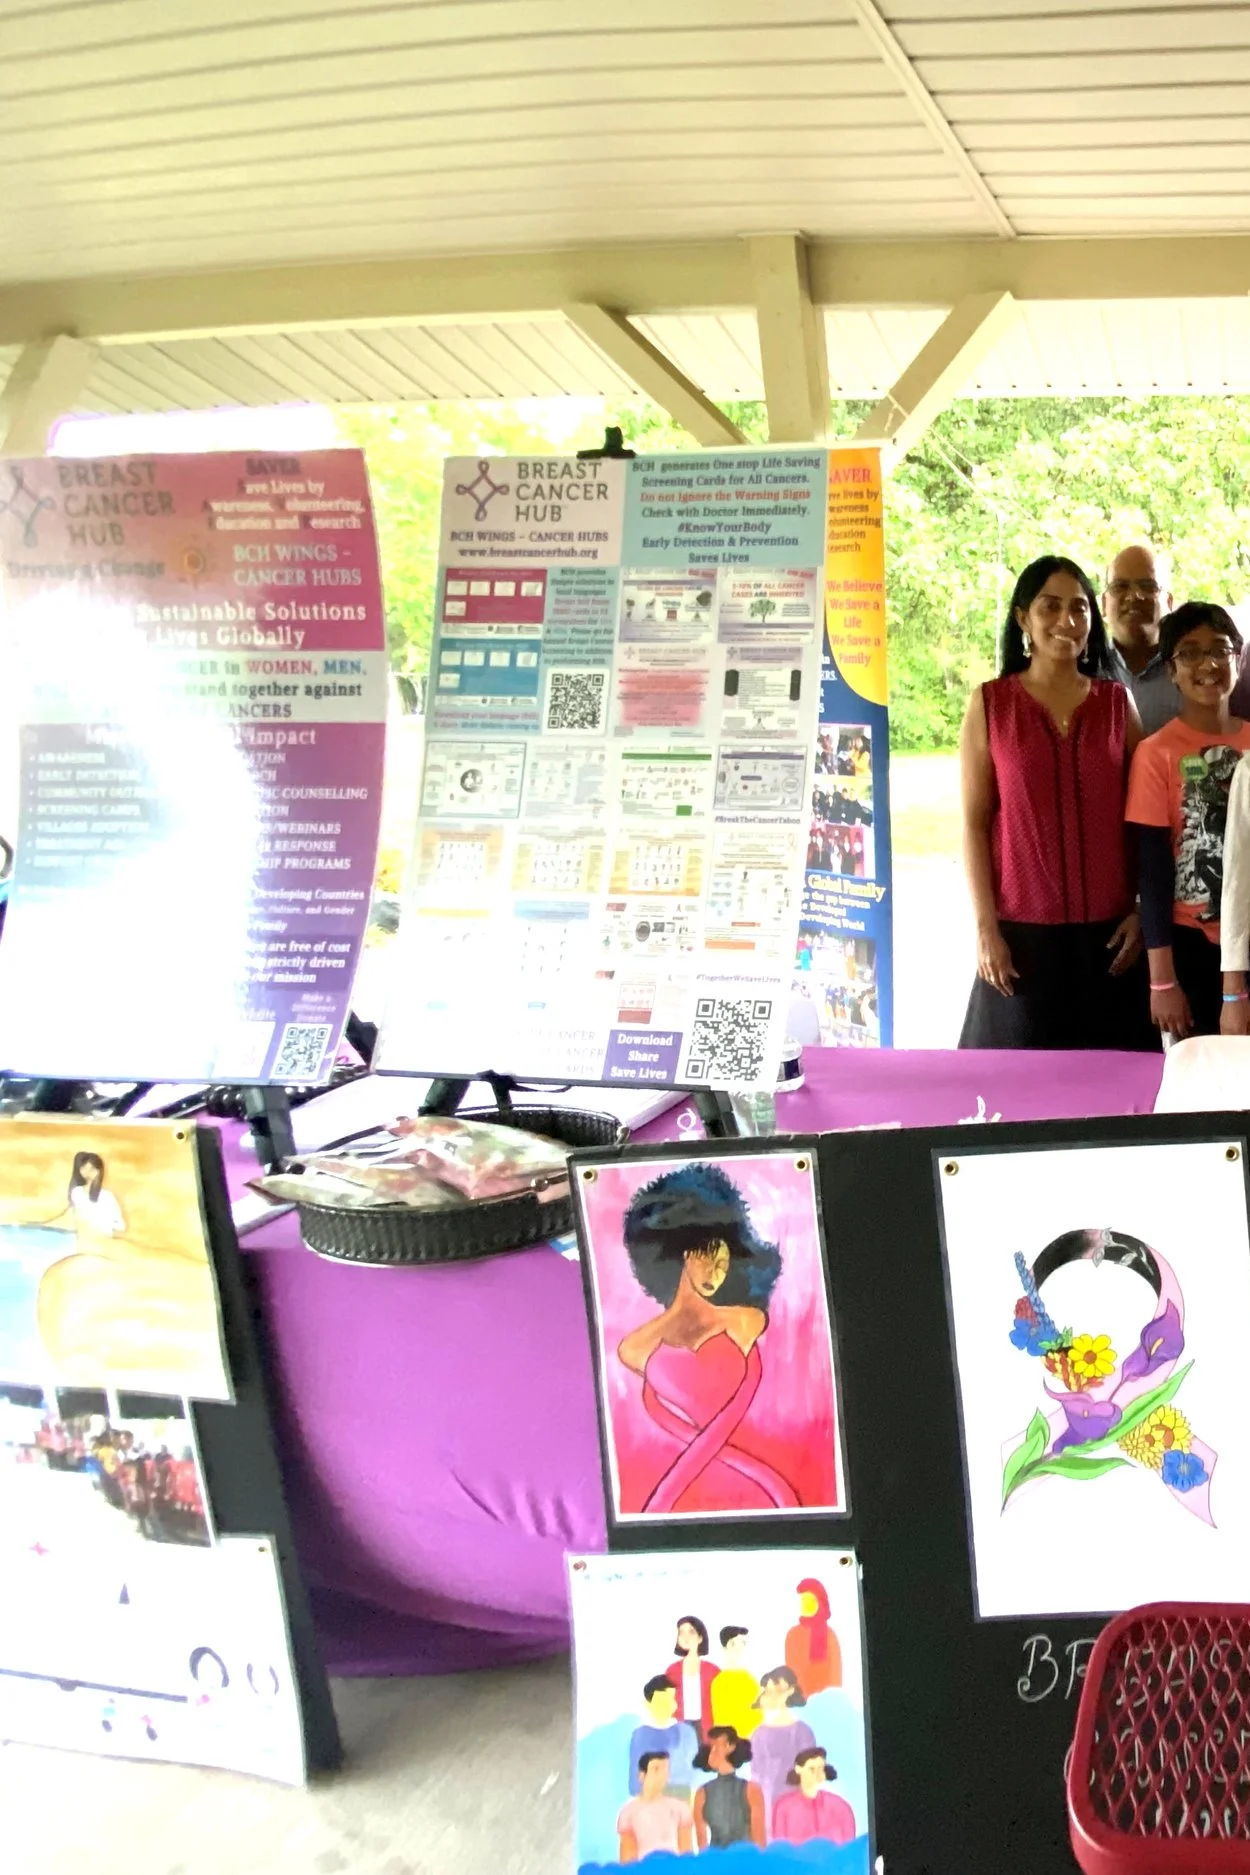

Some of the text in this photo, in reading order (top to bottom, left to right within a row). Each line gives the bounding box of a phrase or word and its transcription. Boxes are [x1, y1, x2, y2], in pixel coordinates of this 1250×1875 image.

[517, 462, 602, 480] BREAST
[632, 456, 821, 473] BCH generates One stop Life Saving
[58, 461, 157, 486] BREAST
[829, 467, 872, 484] AVER
[642, 476, 694, 489] Screening
[696, 475, 726, 487] Cards
[728, 475, 745, 486] for
[747, 474, 762, 485] All
[516, 483, 609, 501] CANCER
[640, 492, 655, 503] Do
[657, 493, 676, 502] not
[715, 490, 731, 501] the
[735, 489, 780, 502] Warning
[782, 489, 811, 501] Signs
[866, 487, 880, 502] by
[63, 491, 174, 517] CANCER
[515, 505, 563, 522] HUB
[641, 506, 674, 518] Check
[676, 506, 699, 517] with
[702, 506, 739, 517] Doctor
[67, 522, 126, 547] HUB
[677, 521, 772, 535] #KnowYourBody
[451, 532, 609, 542] BCH WINGS CANCER HUBS
[642, 535, 799, 550] Early Detection & Prevention
[233, 544, 338, 562] BCH WINGS
[458, 547, 599, 560] www.breastcancerhub.org
[688, 552, 750, 563] Saves Lives
[233, 568, 362, 586] CANCER HUBS
[827, 579, 882, 592] We Believe
[137, 602, 367, 622] Sustainable Solutions
[830, 600, 845, 611] We
[846, 599, 871, 611] Save
[843, 616, 862, 628] Life
[155, 626, 306, 649] Lives Globally
[831, 635, 846, 647] We
[847, 635, 872, 647] Save
[838, 652, 872, 667] Family
[244, 659, 319, 677] WOMEN,
[322, 659, 368, 676] MEN,
[232, 682, 299, 702] together
[304, 682, 363, 702] against
[248, 727, 317, 750] Impact
[281, 786, 368, 800] COUNSELLING
[274, 839, 337, 853] RESPONSE
[283, 857, 352, 870] PROGRAMS
[314, 888, 366, 901] Countries
[843, 878, 887, 903] Family
[267, 940, 352, 953] are free of cost
[308, 955, 346, 969] driven
[617, 1034, 674, 1046] Download
[627, 1050, 660, 1062] Share
[610, 1065, 668, 1080] Save Lives
